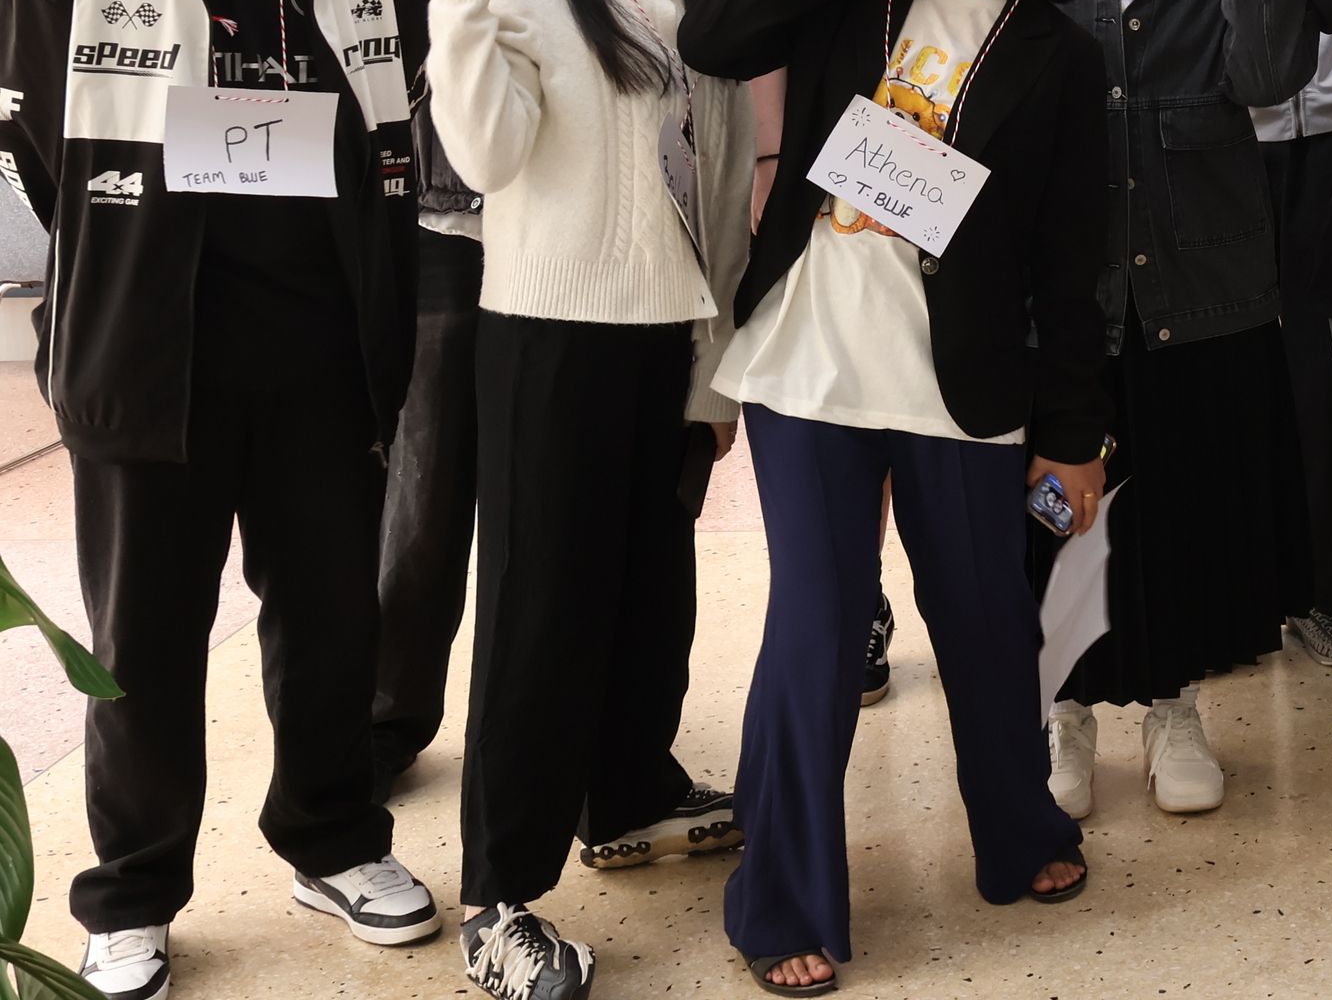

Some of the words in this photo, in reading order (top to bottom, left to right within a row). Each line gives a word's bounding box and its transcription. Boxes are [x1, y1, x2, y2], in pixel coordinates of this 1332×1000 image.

[225, 119, 283, 163] PT
[396, 156, 411, 164] AND
[845, 136, 944, 205] Athena
[182, 171, 227, 187] TEAM
[238, 170, 268, 183] BLUE
[873, 192, 913, 219] BLUE
